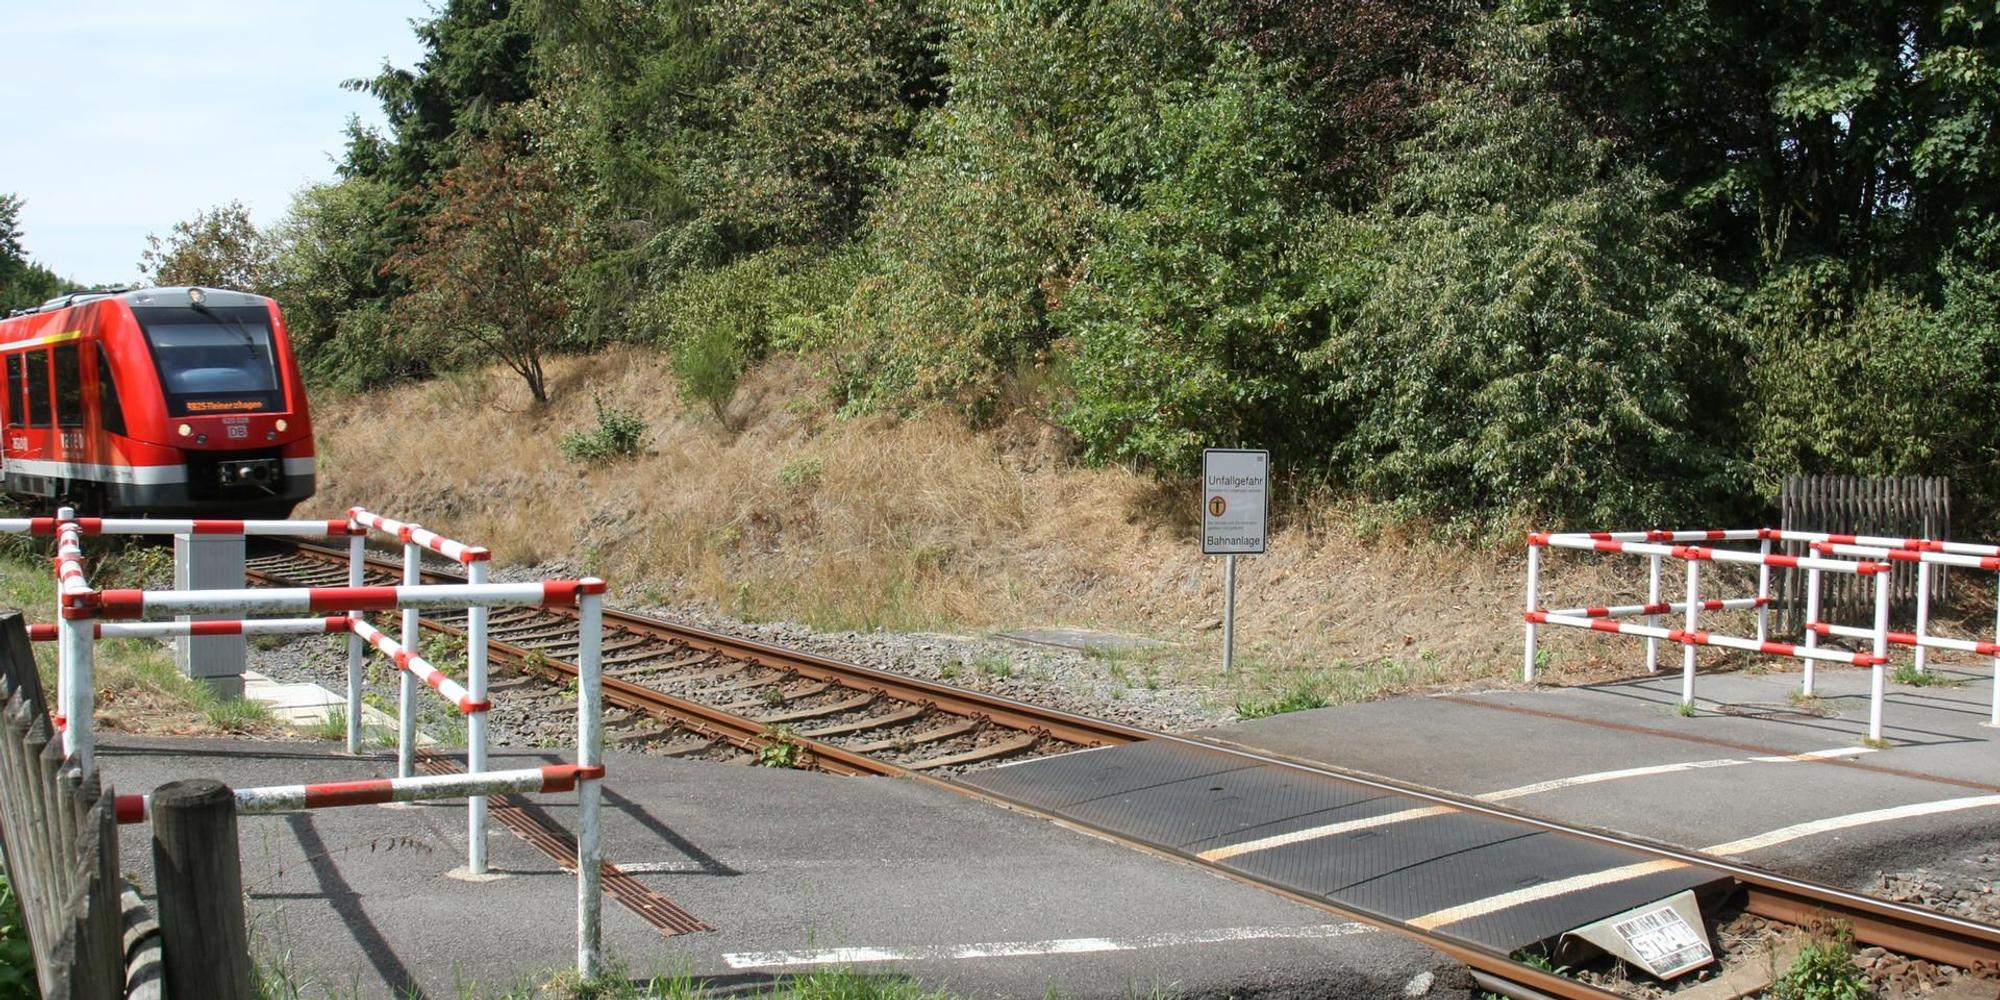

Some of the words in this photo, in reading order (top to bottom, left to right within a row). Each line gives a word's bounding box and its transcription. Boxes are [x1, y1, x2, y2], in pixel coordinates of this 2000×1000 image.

[230, 426, 246, 437] DB
[1208, 475, 1263, 488] Unfallgefahr
[1207, 535, 1260, 548] Bahnanlage
